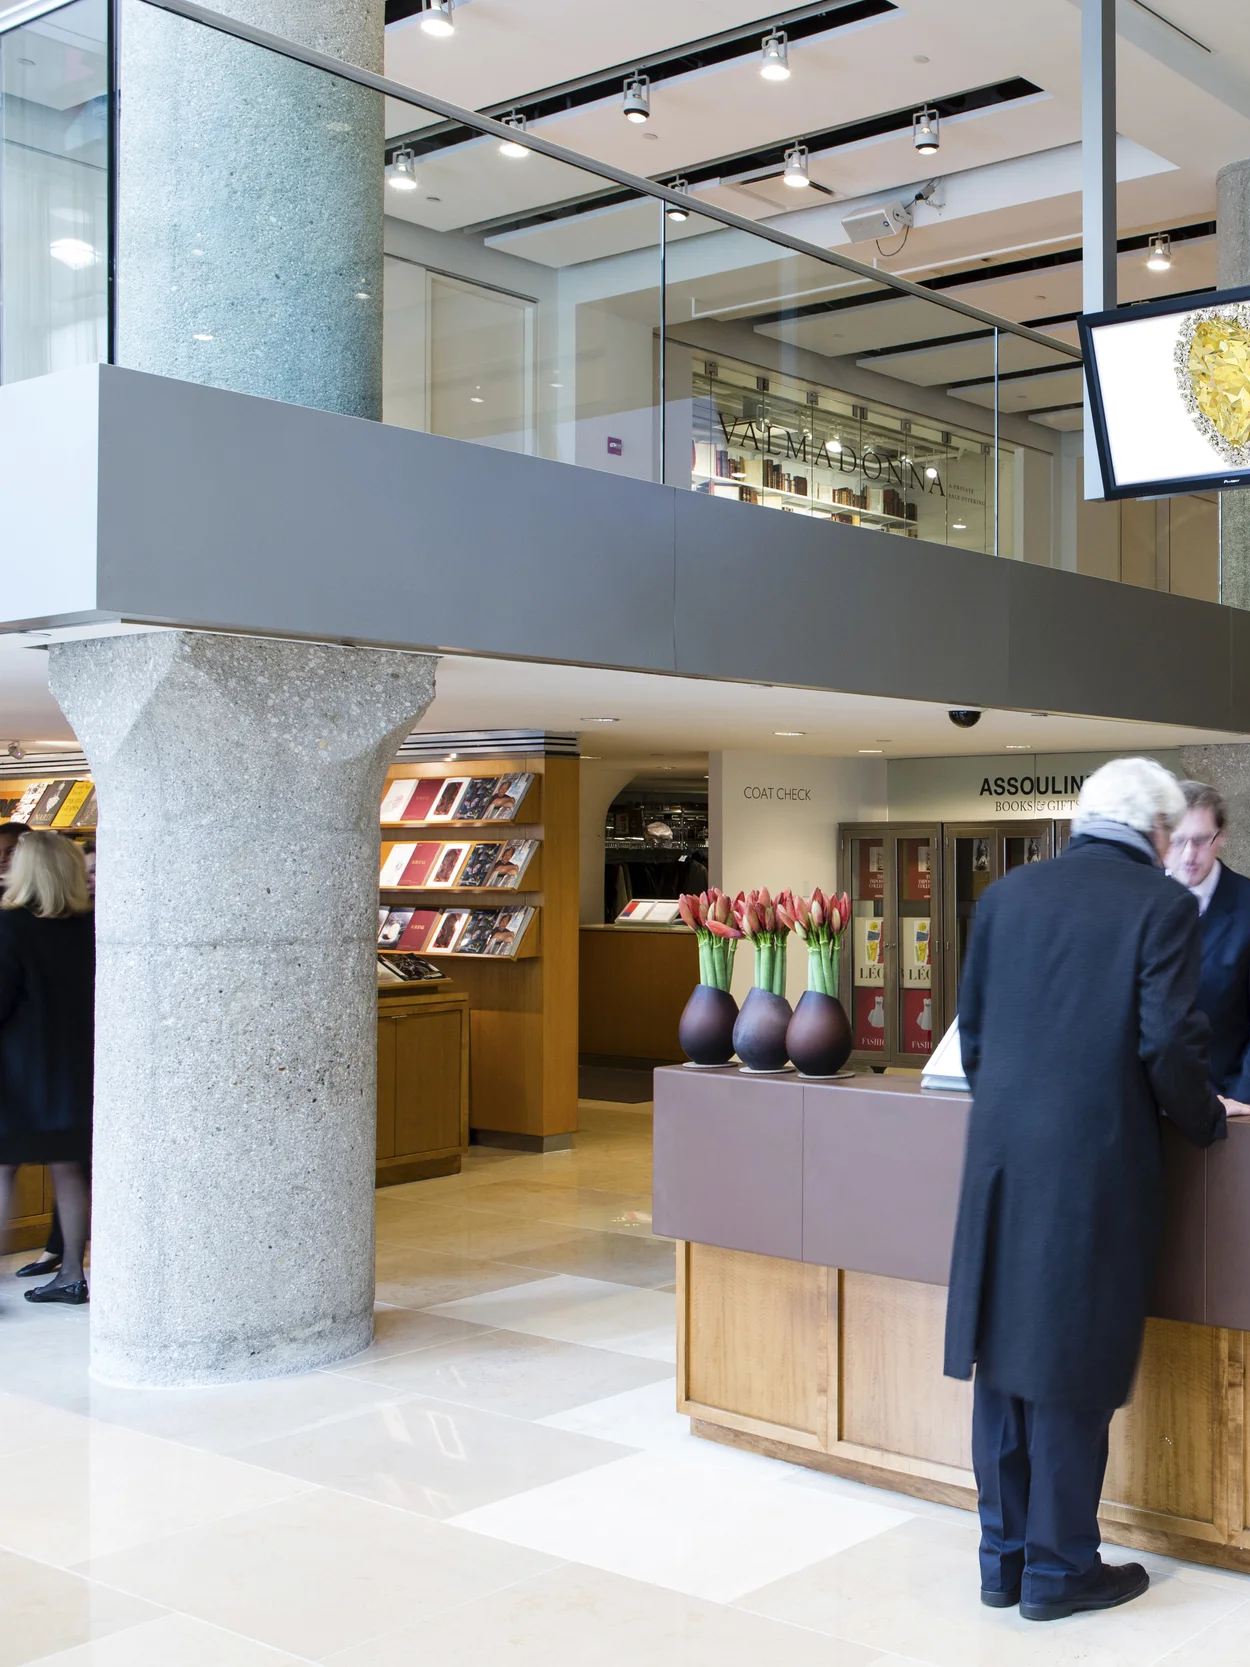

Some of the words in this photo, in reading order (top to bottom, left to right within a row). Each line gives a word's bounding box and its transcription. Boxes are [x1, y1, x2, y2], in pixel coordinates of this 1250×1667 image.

[717, 412, 946, 497] VALMADONNA
[953, 484, 975, 495] PRIVATE
[948, 493, 961, 501] SALE
[961, 496, 987, 507] OFFERING
[979, 775, 1092, 796] ASSOULIN
[743, 786, 774, 800] COAT
[776, 787, 812, 801] CHECK
[995, 801, 1033, 812] BOOKS
[1036, 801, 1047, 812] &
